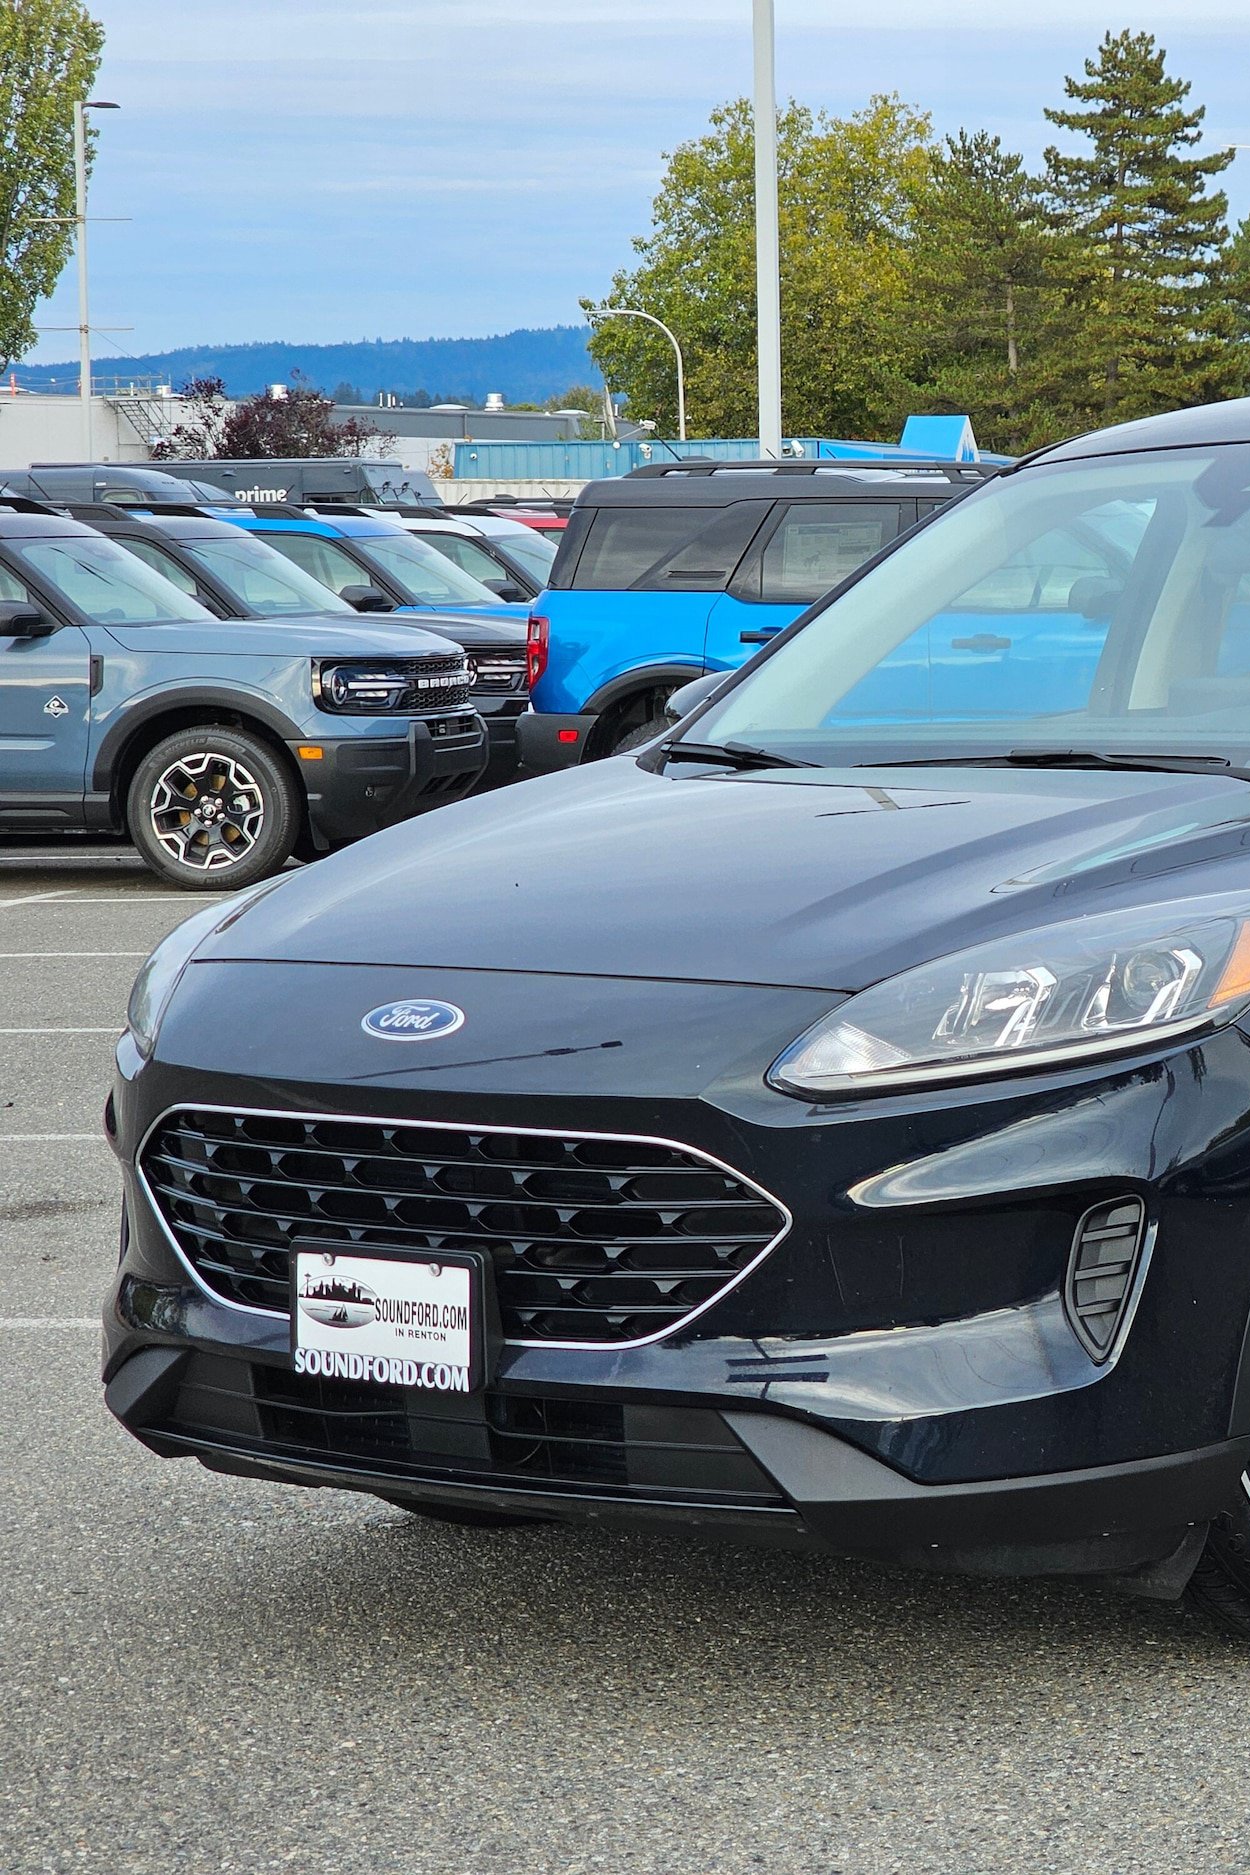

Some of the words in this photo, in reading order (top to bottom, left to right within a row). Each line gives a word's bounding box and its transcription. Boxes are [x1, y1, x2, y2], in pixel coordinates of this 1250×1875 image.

[234, 485, 288, 502] prime
[417, 675, 470, 689] BRONCO
[379, 1004, 440, 1030] Ford
[374, 1298, 468, 1331] SOUNDFORD.COM
[395, 1327, 404, 1337] IN
[408, 1327, 447, 1342] RENTON
[294, 1347, 470, 1393] SOUNDFORD.COM
